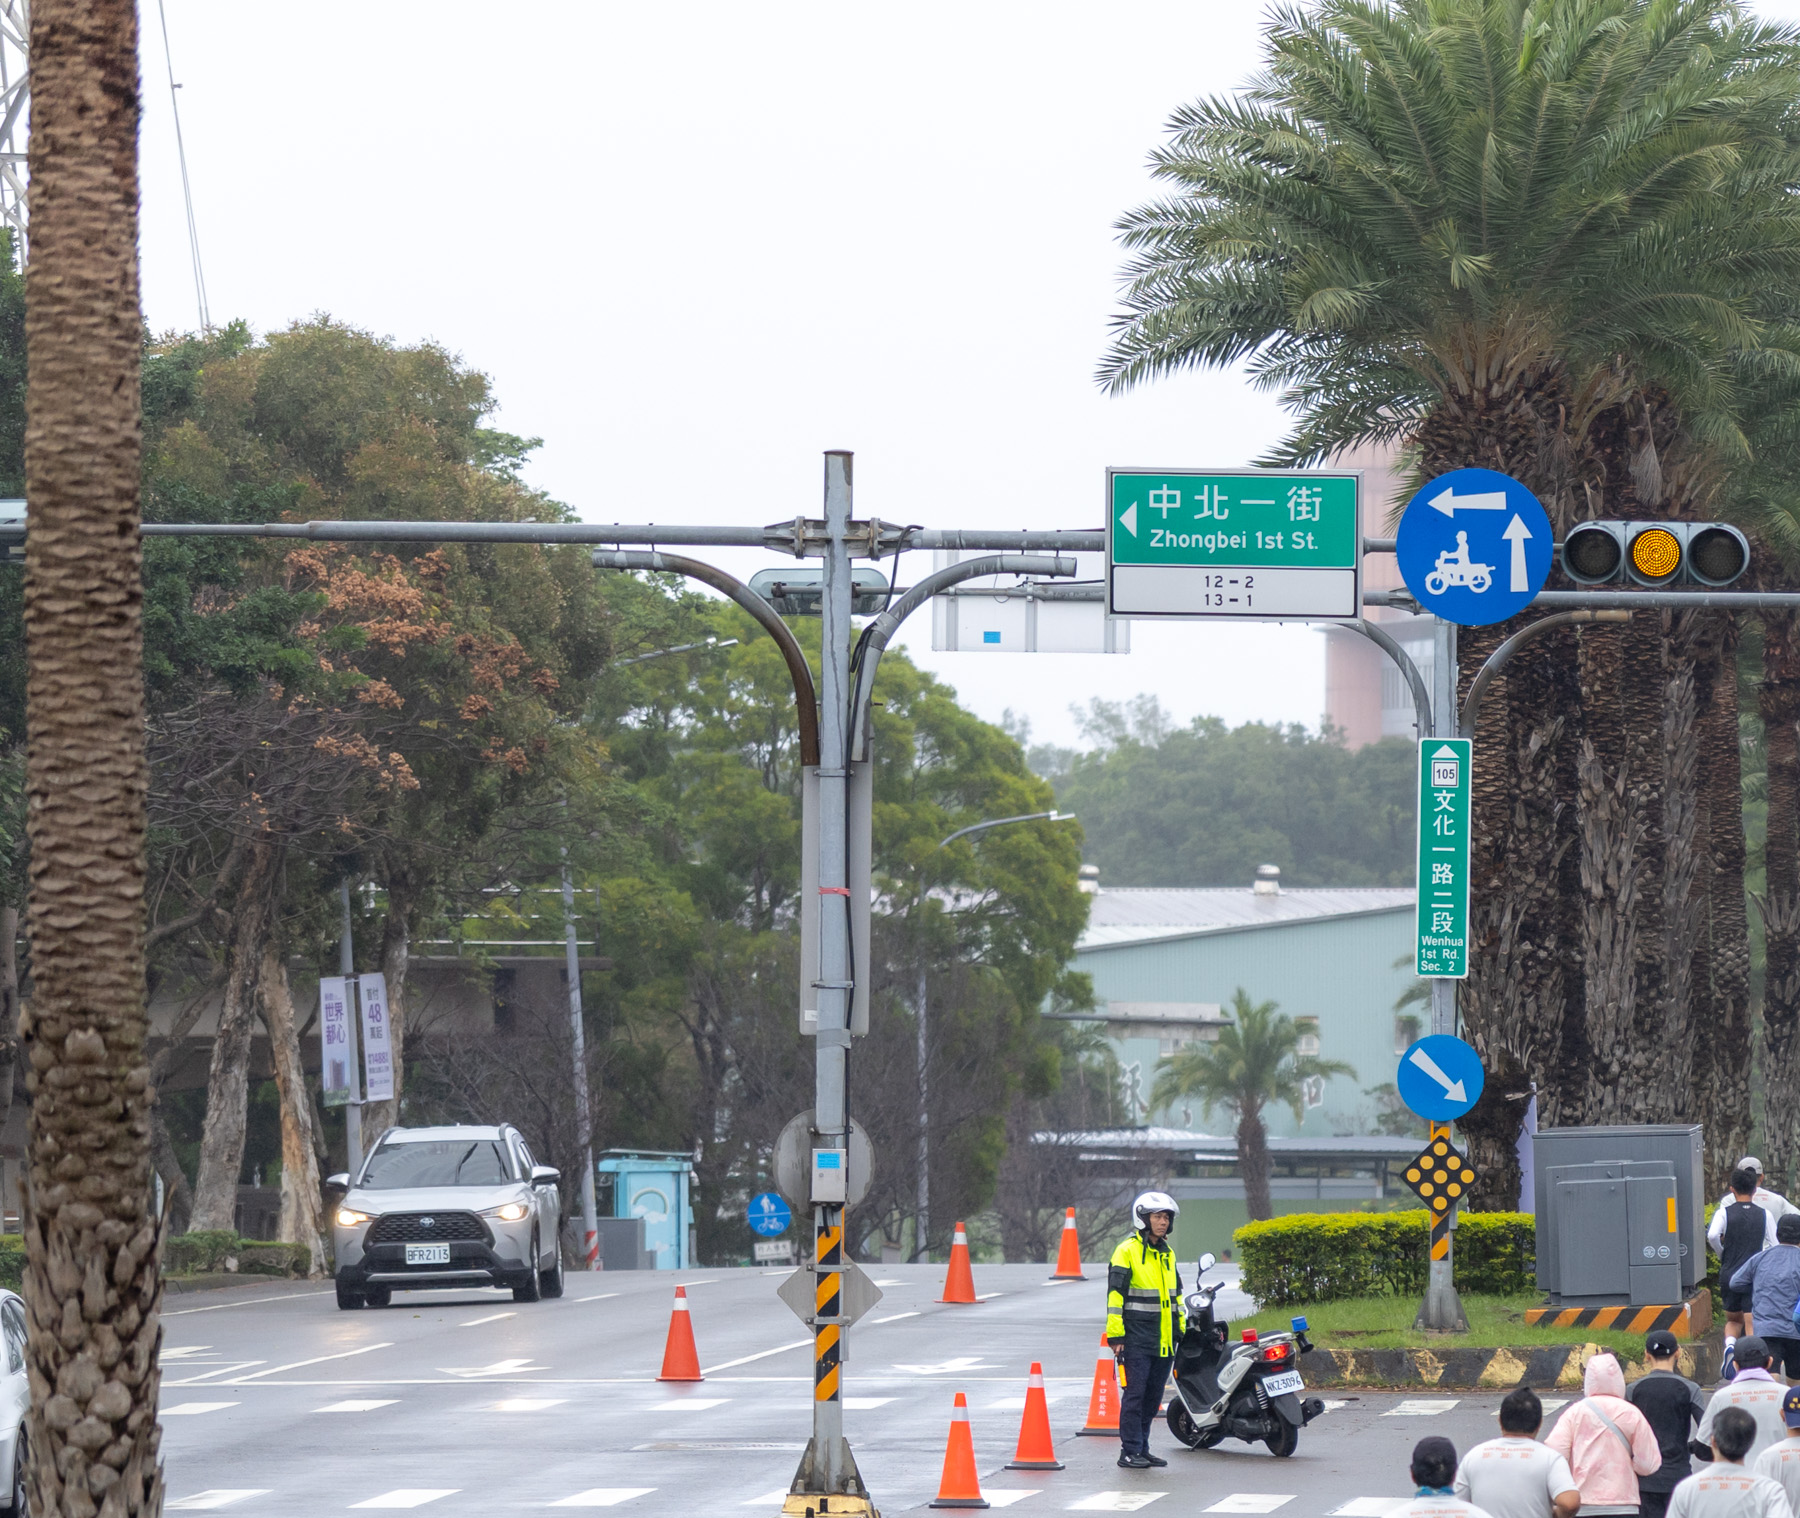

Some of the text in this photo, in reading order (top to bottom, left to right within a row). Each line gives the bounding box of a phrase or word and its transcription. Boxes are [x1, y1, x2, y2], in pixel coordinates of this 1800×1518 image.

[1149, 483, 1322, 521] 中北一街
[1150, 529, 1319, 554] Zhongbei 1st St.
[1436, 769, 1455, 779] 105
[1431, 790, 1456, 933] 文化一路二段
[1421, 935, 1464, 946] Wenhua
[1421, 948, 1460, 959] 1st Rd.
[1421, 960, 1455, 971] Sec. 2
[368, 1003, 382, 1023] 48
[1267, 1374, 1302, 1393] NKZ-3096
